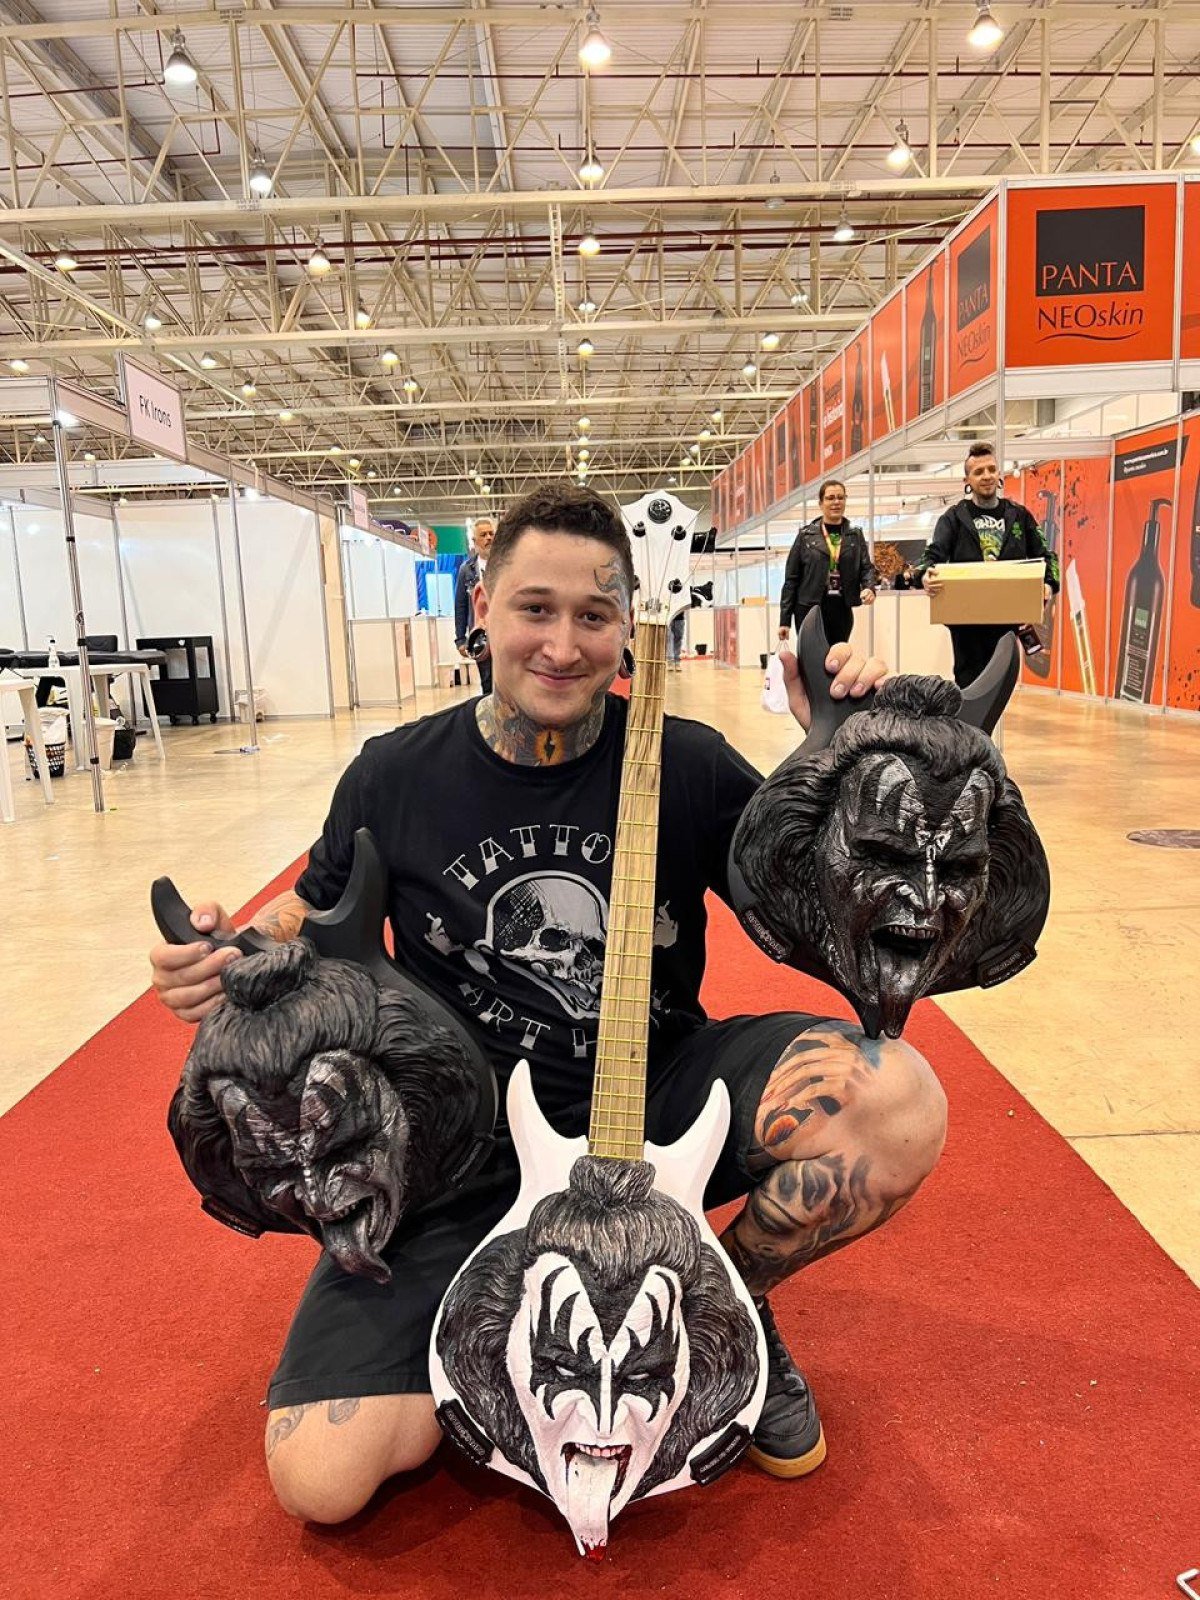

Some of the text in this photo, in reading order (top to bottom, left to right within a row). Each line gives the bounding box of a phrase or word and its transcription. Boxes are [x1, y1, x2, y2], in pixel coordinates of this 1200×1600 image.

[1041, 260, 1137, 290] PANTA
[958, 282, 989, 323] PANTA
[1038, 301, 1144, 331] NEOskin
[139, 394, 172, 428] FK Irons
[442, 824, 612, 891] TATTO
